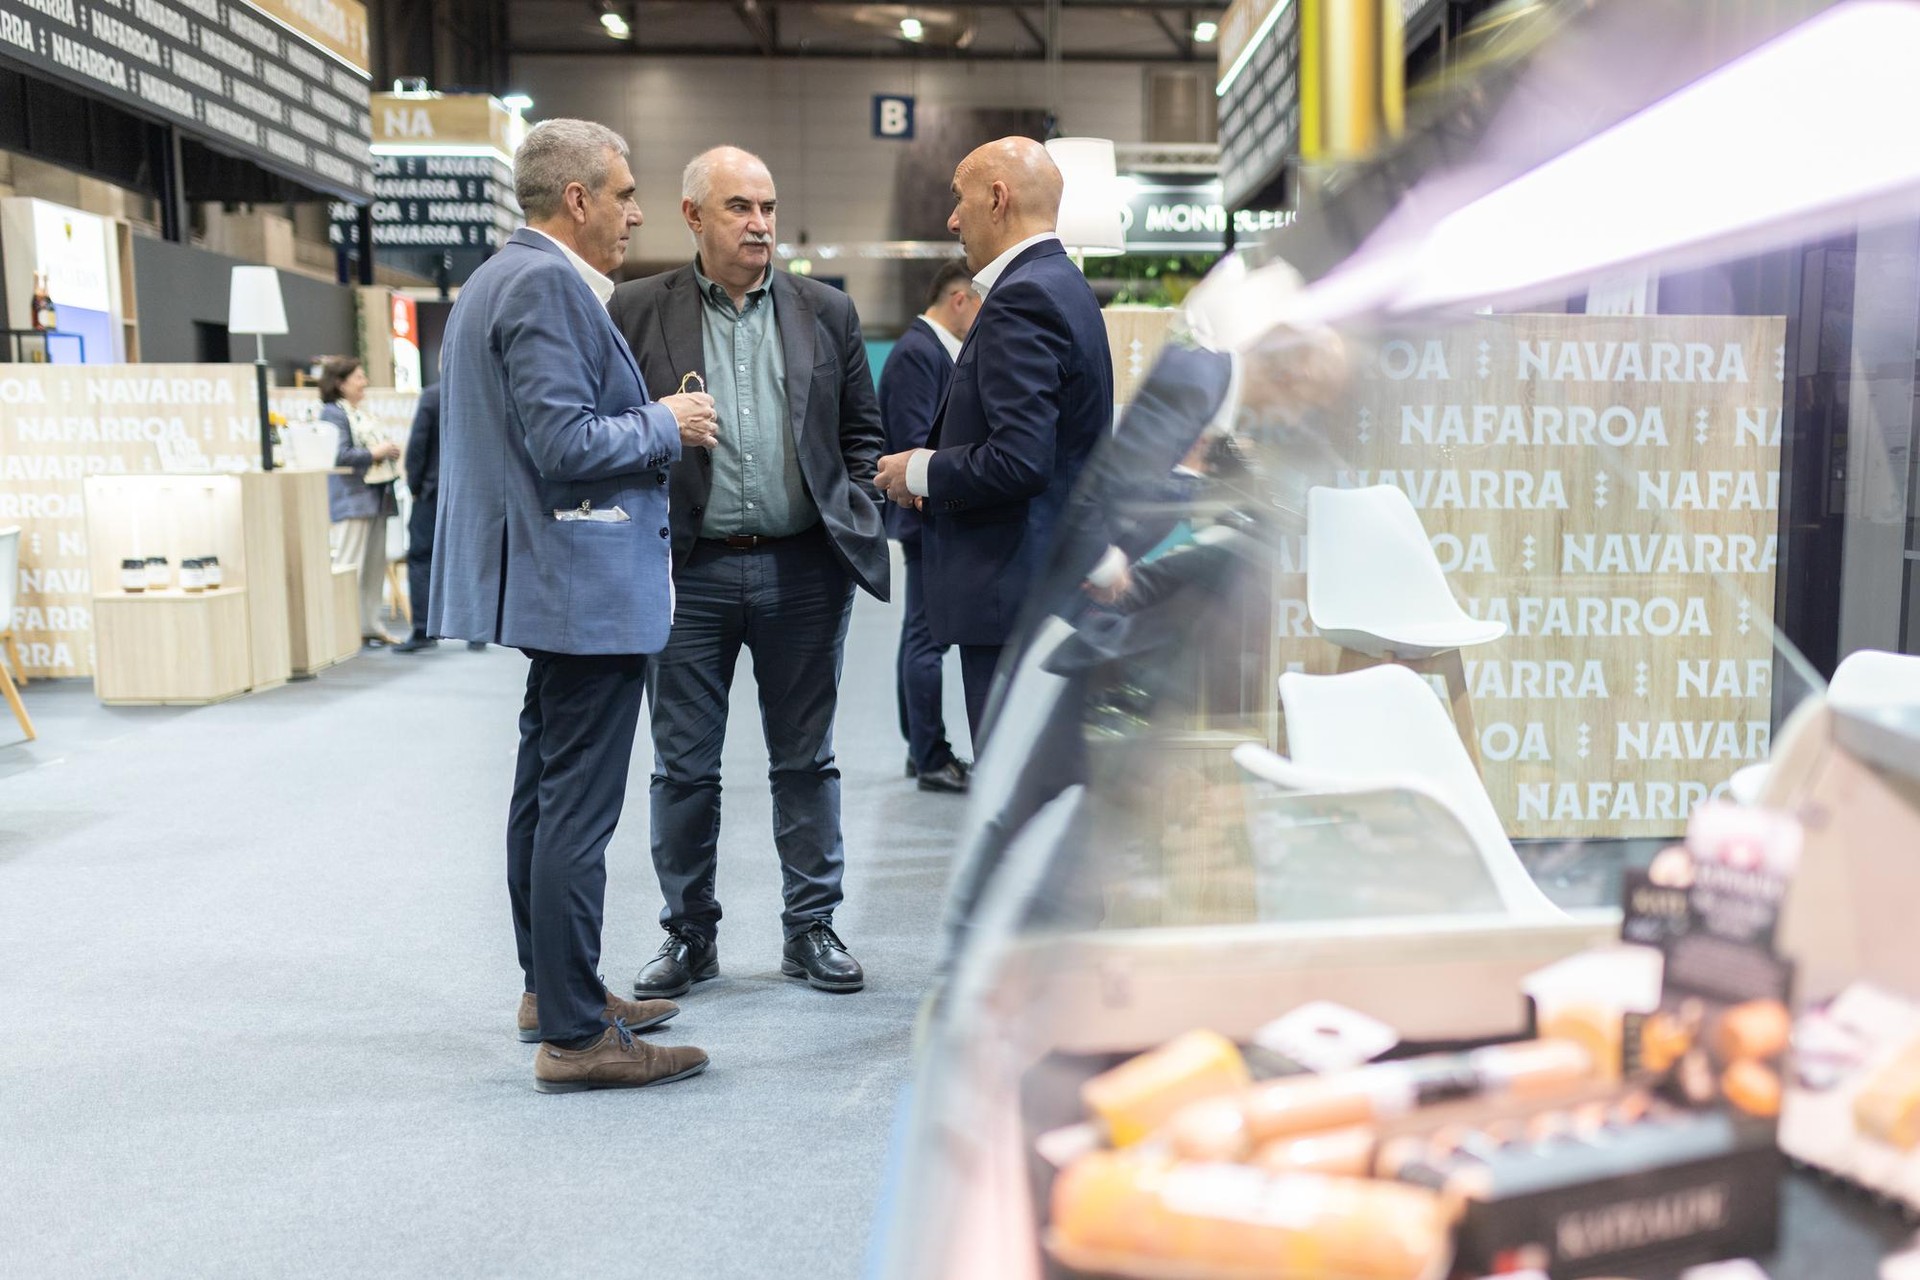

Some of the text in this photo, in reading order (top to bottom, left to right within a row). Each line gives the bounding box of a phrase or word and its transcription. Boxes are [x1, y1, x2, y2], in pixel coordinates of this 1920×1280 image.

[91, 8, 162, 68] NAFARROA
[51, 31, 128, 91] NAFARROA
[383, 107, 434, 138] NA
[881, 100, 908, 135] B
[371, 224, 463, 245] NAVARRA
[1517, 340, 1749, 383] NAVARRA
[0, 378, 236, 404] OA NAVARRA
[17, 417, 189, 442] NAFARROA
[1400, 404, 1670, 447] NAFARROA
[0, 454, 126, 480] AVARRA
[57, 531, 87, 556] N
[1562, 533, 1778, 573] NAVARRA
[12, 605, 93, 631] FARR
[1481, 721, 1771, 761] OA NAVAR
